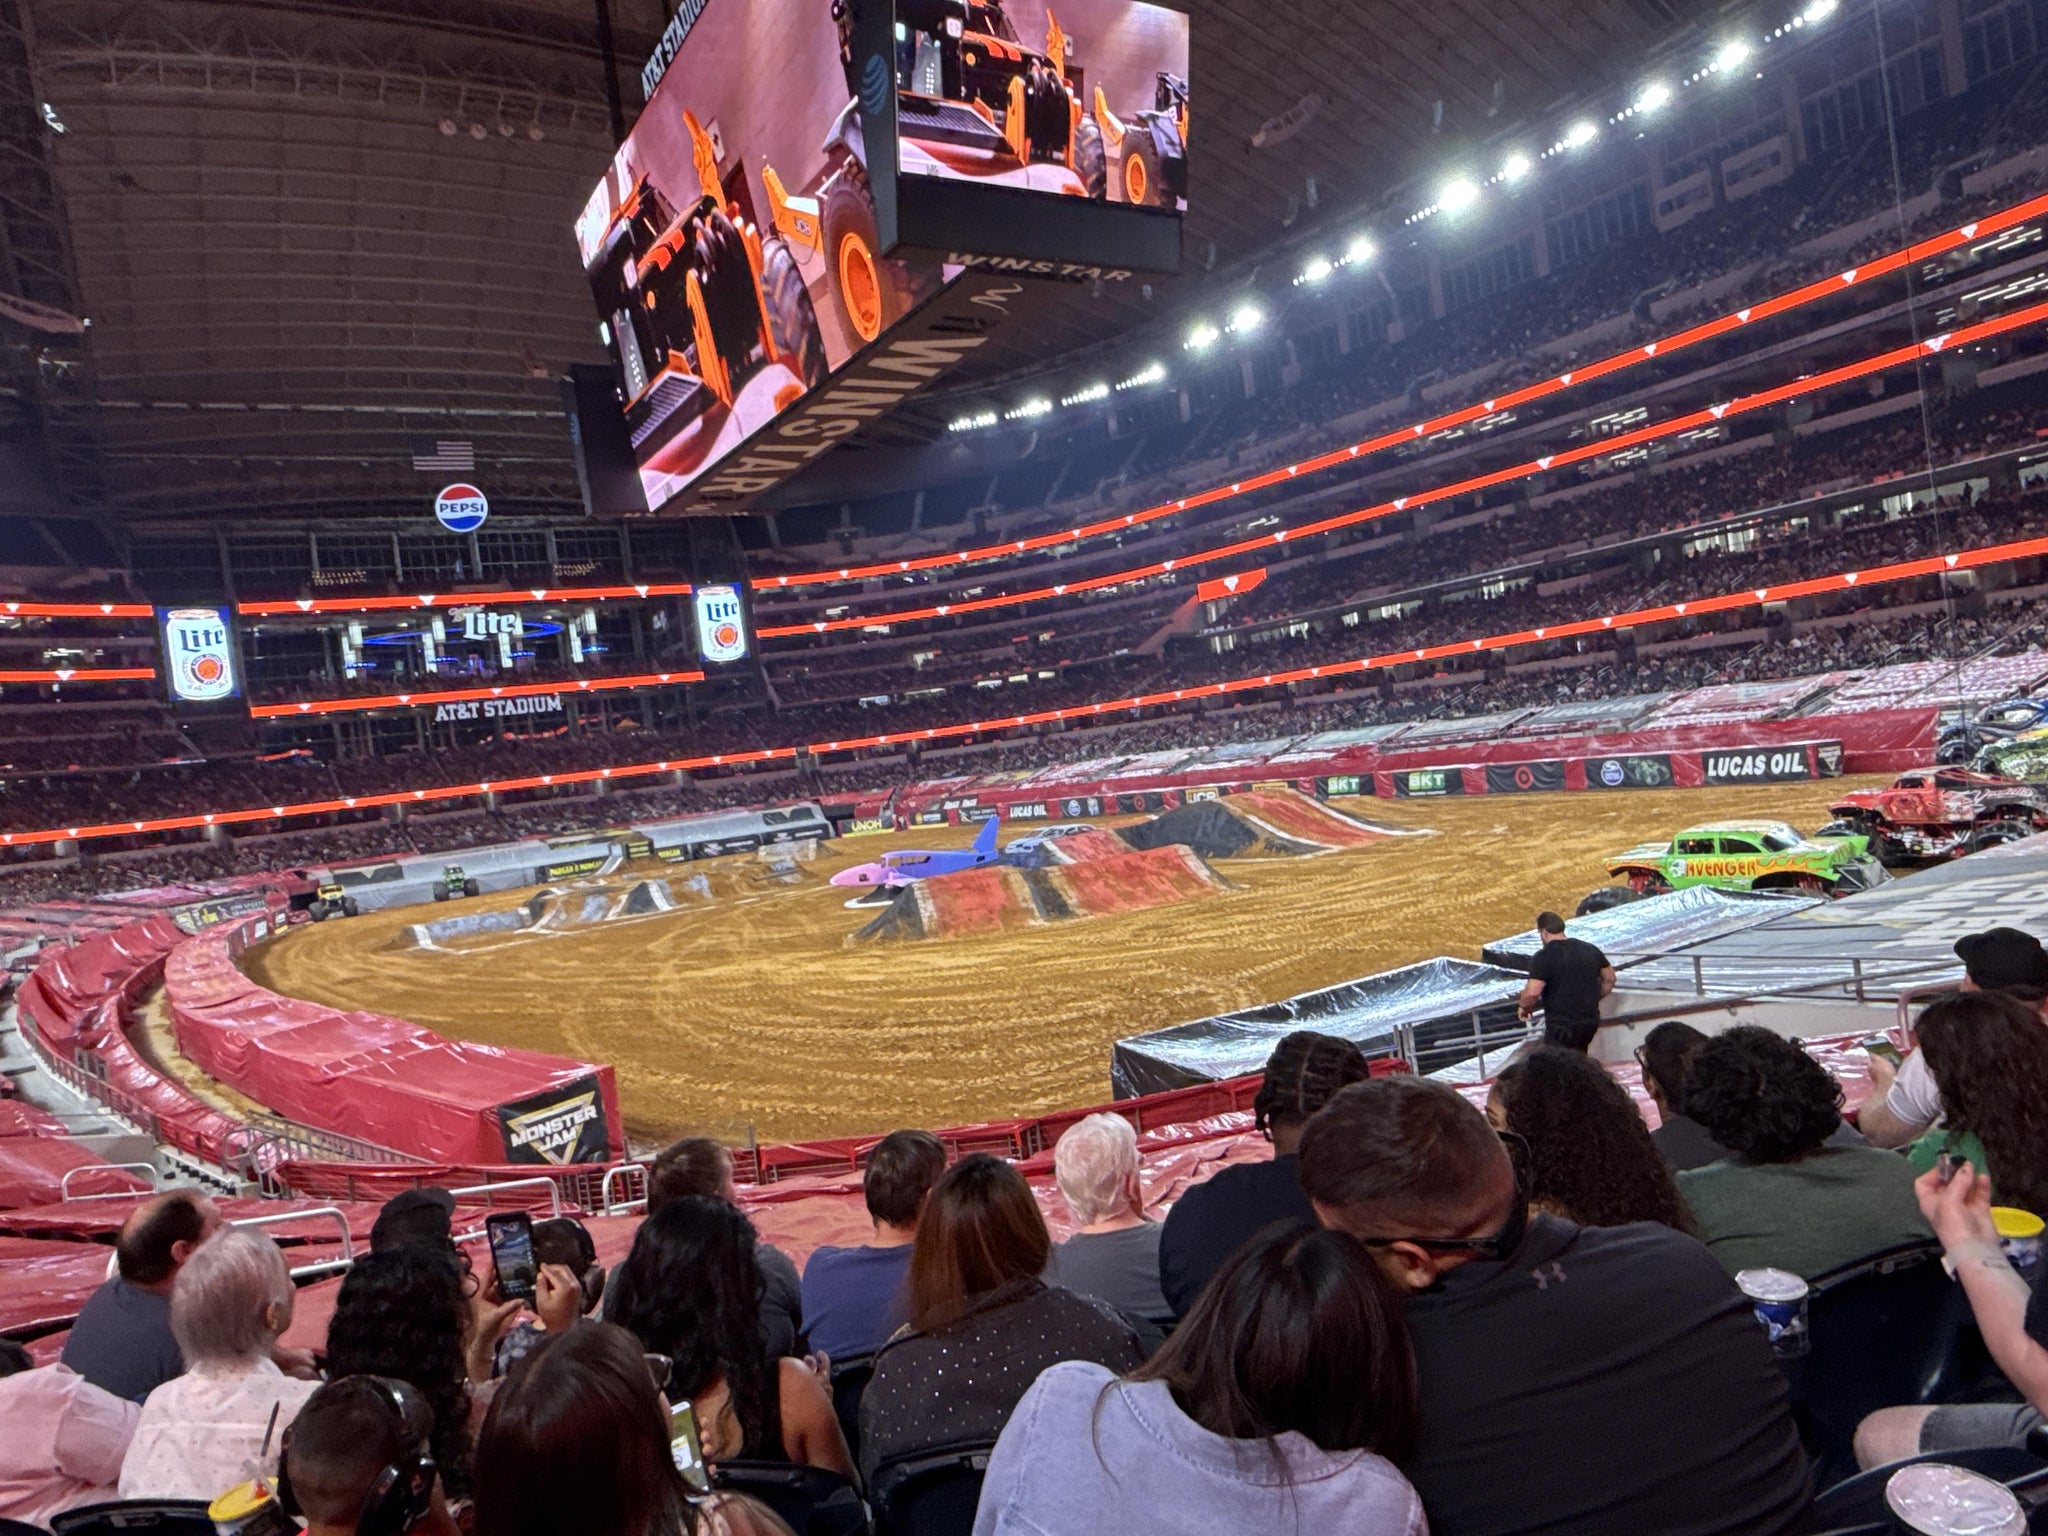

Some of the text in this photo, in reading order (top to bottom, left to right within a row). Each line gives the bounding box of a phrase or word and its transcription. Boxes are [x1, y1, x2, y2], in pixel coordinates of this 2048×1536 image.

[641, 0, 709, 102] AT&T STADIU
[948, 252, 1133, 282] WINSTAR
[698, 337, 989, 494] WINSTAR
[439, 502, 485, 513] PEPSI
[705, 602, 738, 623] Lite
[463, 611, 517, 641] Lite
[177, 628, 224, 653] Lite
[434, 695, 563, 722] AT&T STADIUM
[1707, 754, 1767, 778] LUCAS
[1328, 776, 1360, 793] BKT
[1409, 772, 1446, 790] BKT
[1010, 805, 1032, 818] LUCAS
[851, 818, 883, 833] UNOH
[1684, 857, 1757, 878] AVENGER
[509, 1104, 598, 1152] MONSTER JAM
